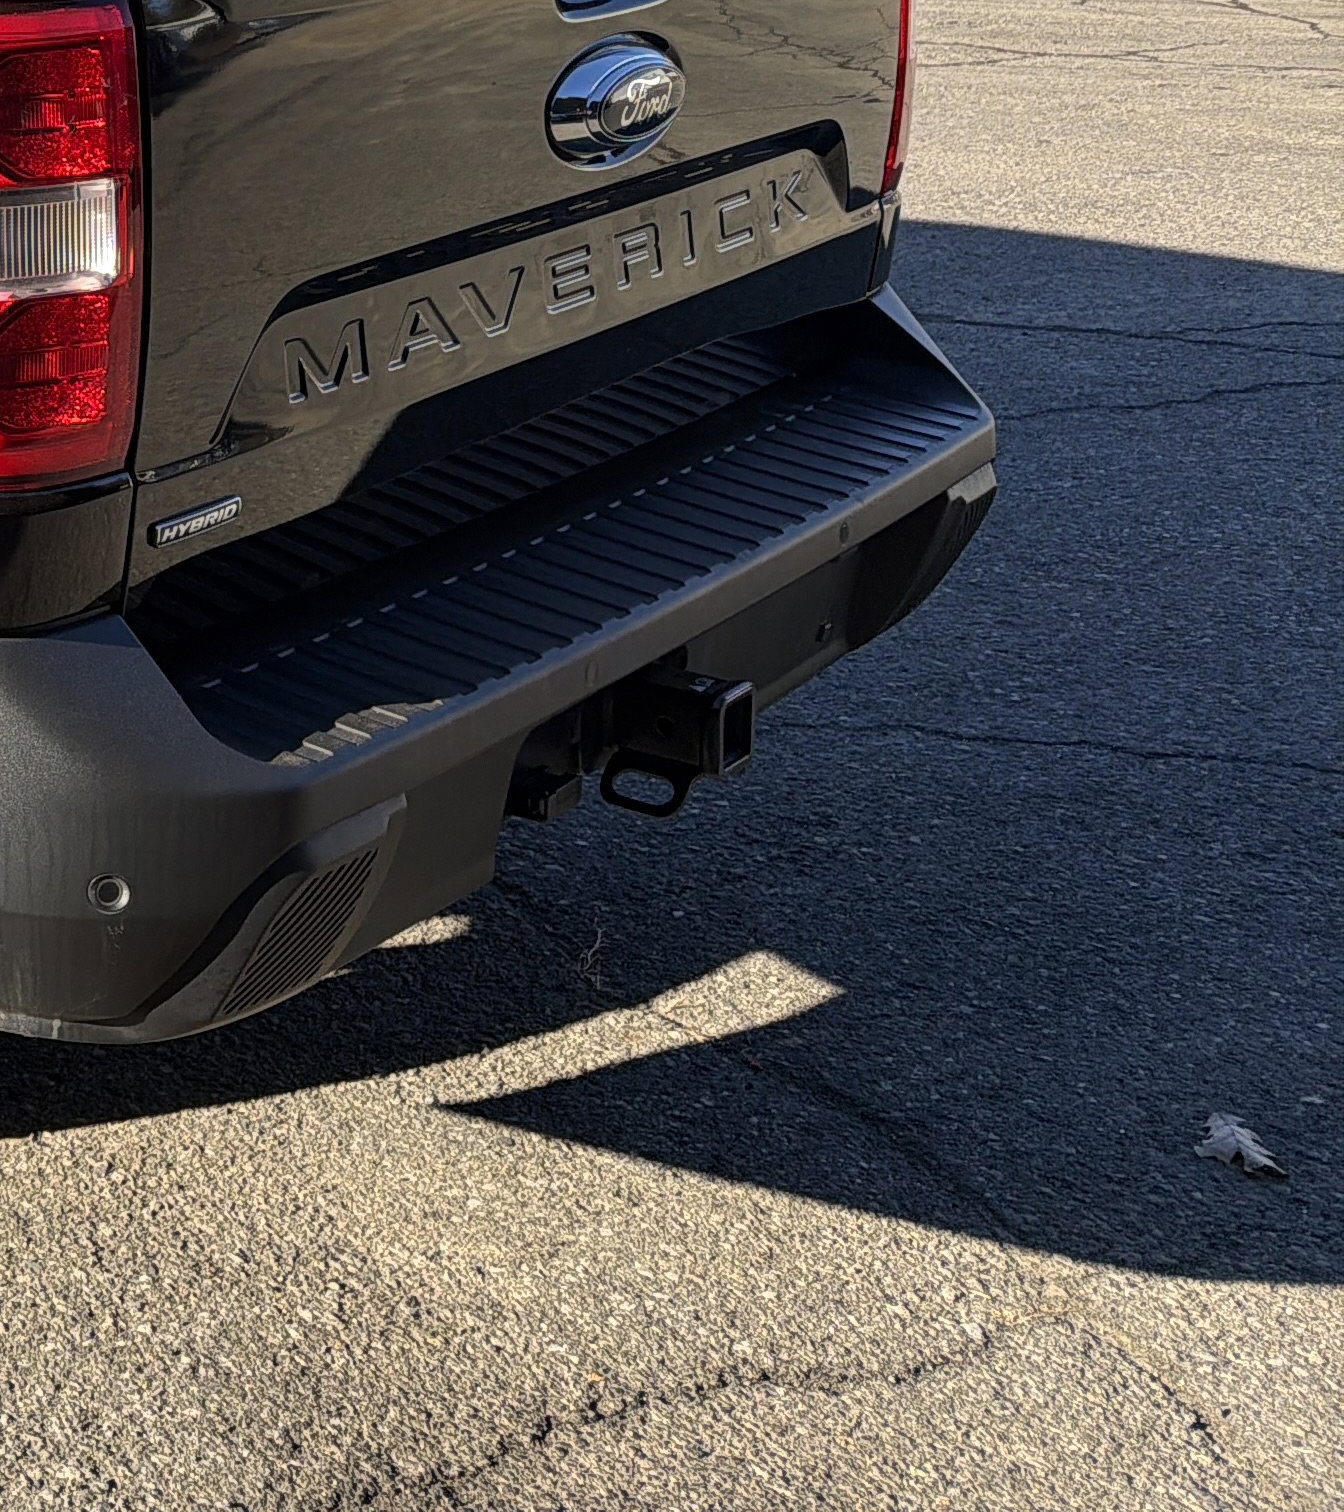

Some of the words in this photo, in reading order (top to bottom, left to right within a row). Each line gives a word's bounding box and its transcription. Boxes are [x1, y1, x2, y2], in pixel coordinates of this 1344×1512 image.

[621, 75, 673, 127] Ford
[283, 170, 809, 404] MAVERICK
[161, 503, 238, 543] HYBRID
